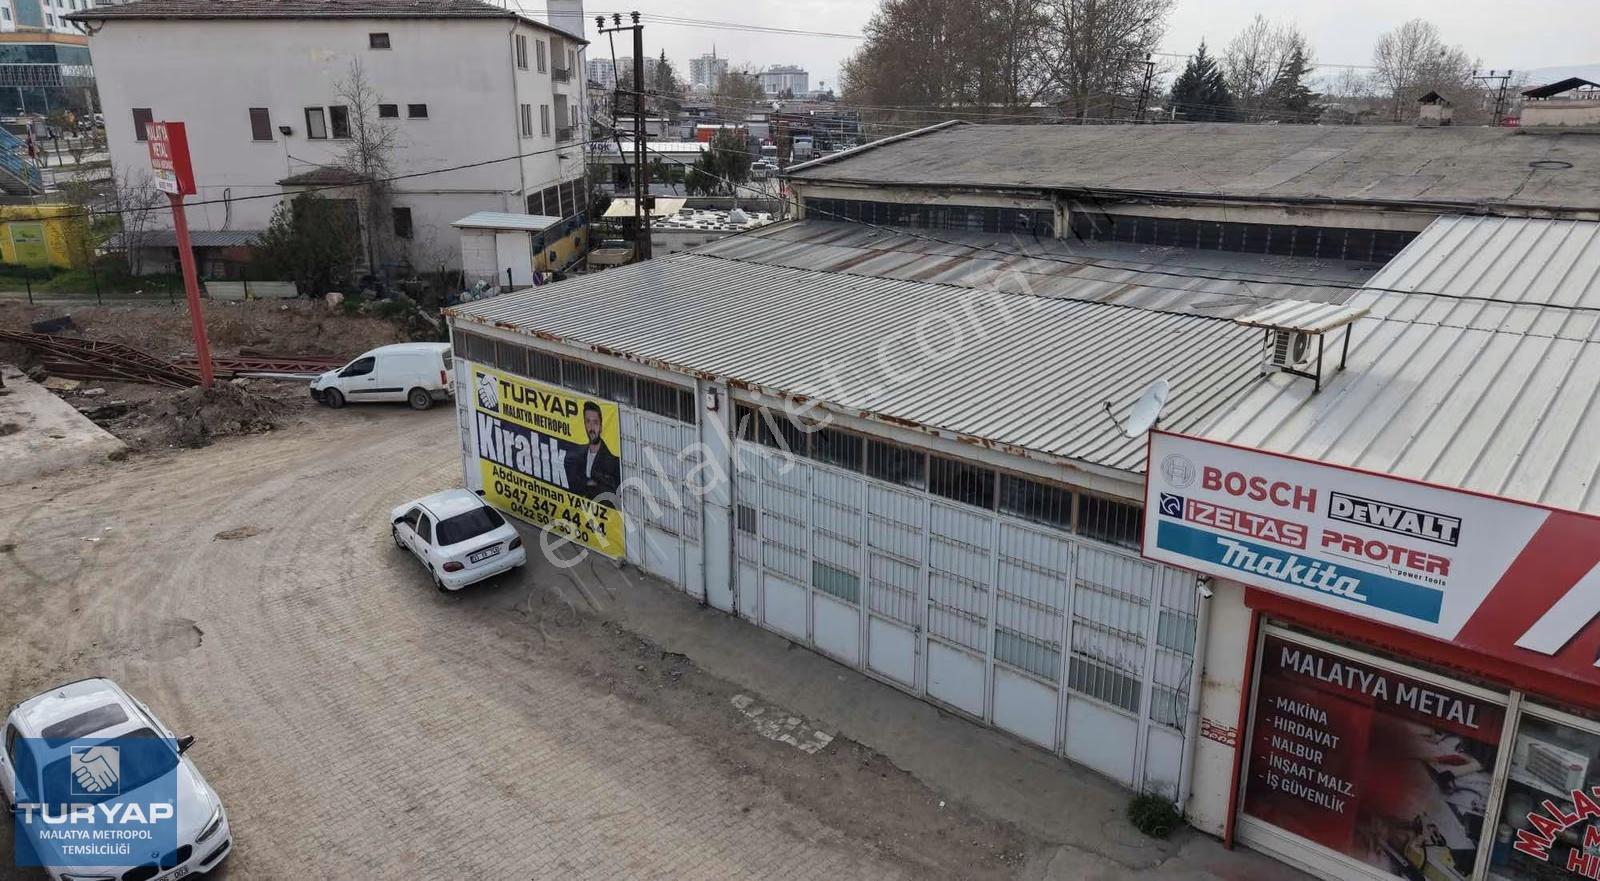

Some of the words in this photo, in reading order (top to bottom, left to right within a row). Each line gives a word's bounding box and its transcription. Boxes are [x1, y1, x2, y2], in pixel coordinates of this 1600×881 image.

[500, 381, 579, 418] TURYAP
[503, 403, 533, 425] MALATYA
[533, 414, 572, 437] METROPOL
[493, 465, 565, 503] Abdurrahman
[567, 493, 609, 521] YAVUZ
[494, 480, 528, 505] 0547
[532, 495, 557, 517] 347
[562, 509, 581, 529] 44
[1202, 466, 1318, 513] BOSCH
[510, 501, 535, 520] 0422
[1321, 529, 1451, 577] PROTER
[1397, 570, 1422, 581] power
[1424, 576, 1447, 586] tools
[1280, 646, 1388, 701] MALATYA
[1395, 681, 1480, 730] METAL
[1276, 696, 1328, 725] MAKİNA
[1271, 735, 1323, 764] NALBUR
[1274, 715, 1340, 749] HIRDAVAT
[1266, 769, 1279, 790] İŞ
[1281, 778, 1345, 814] GÜVENLİK
[1269, 751, 1316, 781] İNŞAAT
[1316, 771, 1356, 797] MALZ.
